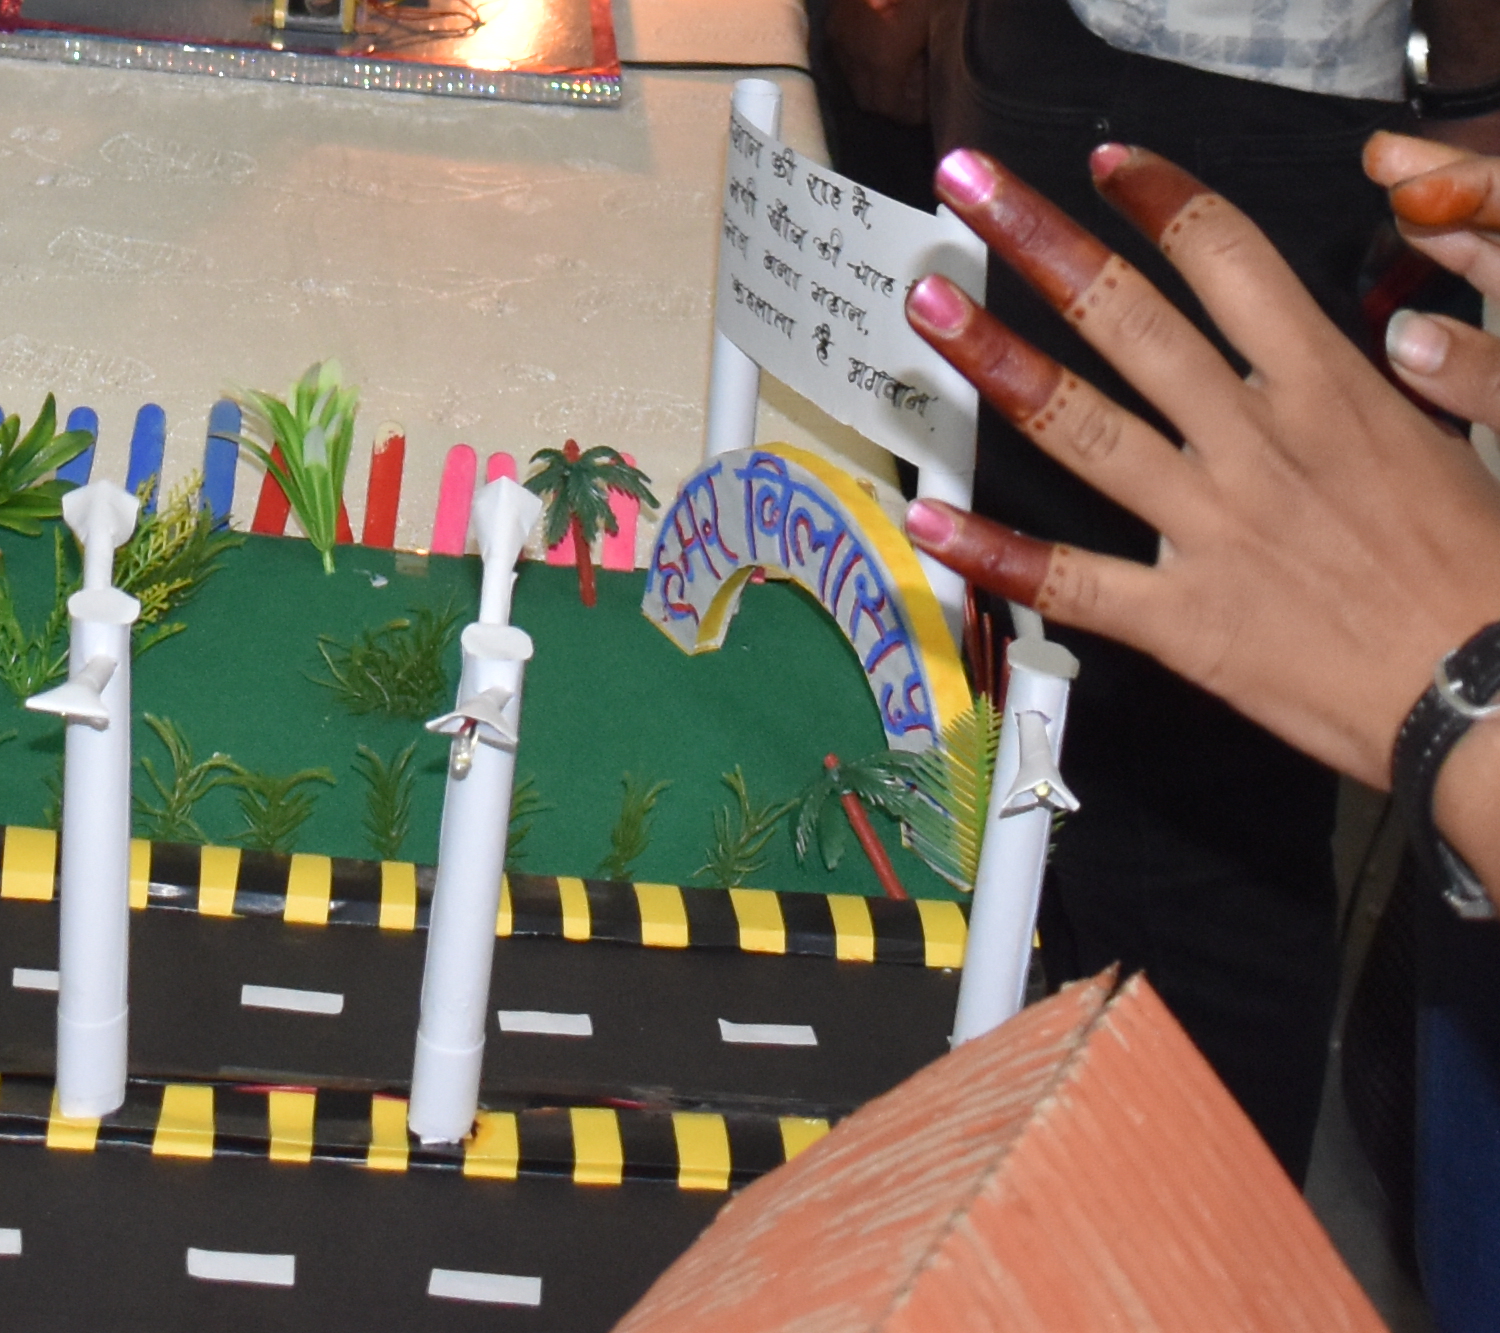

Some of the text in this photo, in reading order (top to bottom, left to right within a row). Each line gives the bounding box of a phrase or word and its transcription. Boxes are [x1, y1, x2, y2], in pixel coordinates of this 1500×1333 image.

[806, 171, 846, 211] राह
[813, 227, 844, 268] की
[846, 259, 897, 299] चाह
[811, 322, 835, 367] है
[647, 459, 742, 626] हमर
